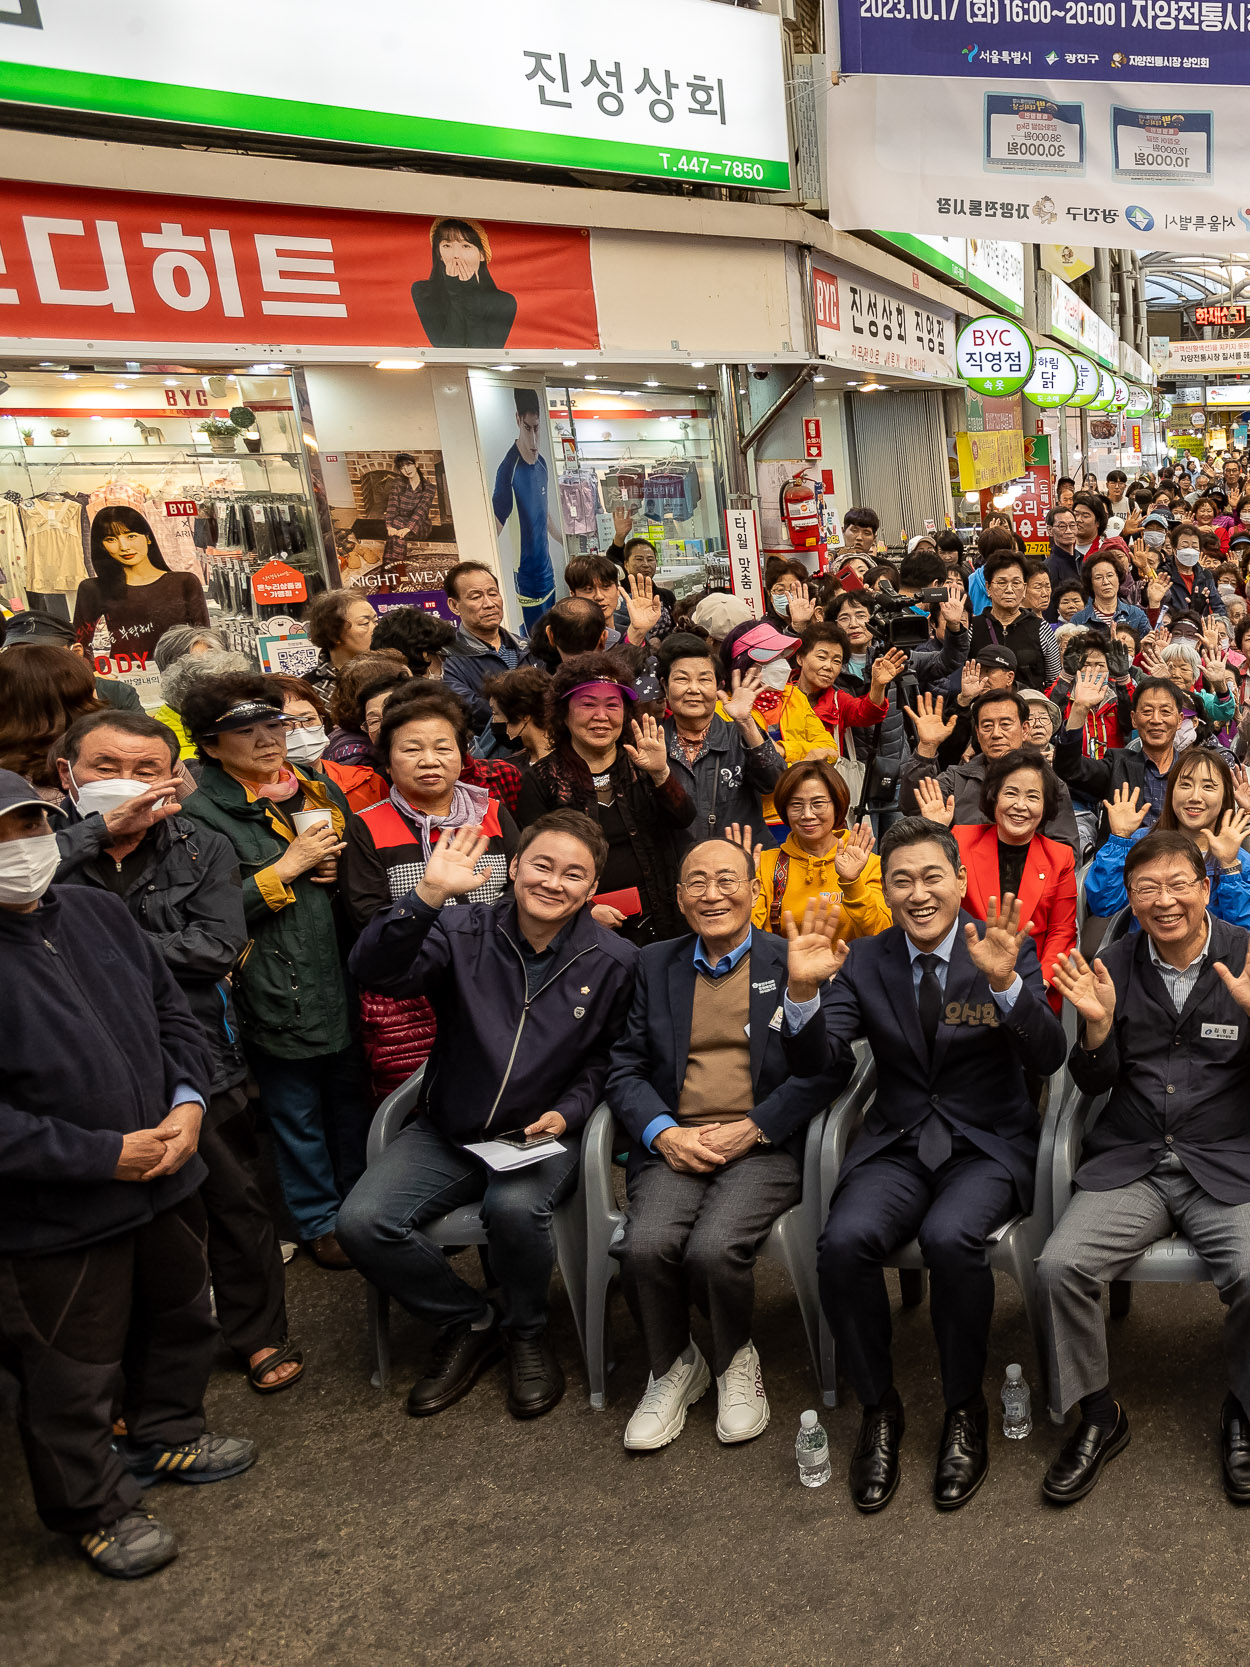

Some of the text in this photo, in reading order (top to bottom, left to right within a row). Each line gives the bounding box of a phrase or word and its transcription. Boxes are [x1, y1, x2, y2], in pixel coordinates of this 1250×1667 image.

[979, 49, 1033, 66] 서울특별시
[1064, 52, 1100, 65] 광진구
[1128, 55, 1210, 69] 자양전통시장 상인회
[523, 48, 729, 126] 진성상회
[658, 152, 764, 182] T.447-7850
[0, 215, 348, 319] 디히트
[816, 279, 838, 325] BYC
[849, 286, 946, 355] 진성상회 직영점
[972, 329, 1012, 347] BYC
[1219, 341, 1238, 351] 지키지
[965, 351, 1022, 373] 직영점
[1180, 353, 1221, 363] 자양전통시장
[1222, 351, 1242, 361] 질서를
[983, 379, 1005, 391] 속옷
[1041, 371, 1057, 389] 닭
[164, 389, 209, 406] BYC
[169, 502, 194, 515] BYC
[1013, 500, 1038, 516] 오리
[734, 516, 749, 550] 타월
[1012, 519, 1050, 538] 용닭
[1025, 543, 1052, 552] 7-721
[349, 573, 400, 587] NIGHT
[738, 557, 752, 590] 맞춤
[118, 622, 155, 641] 부탁해!
[94, 651, 149, 675] ODY
